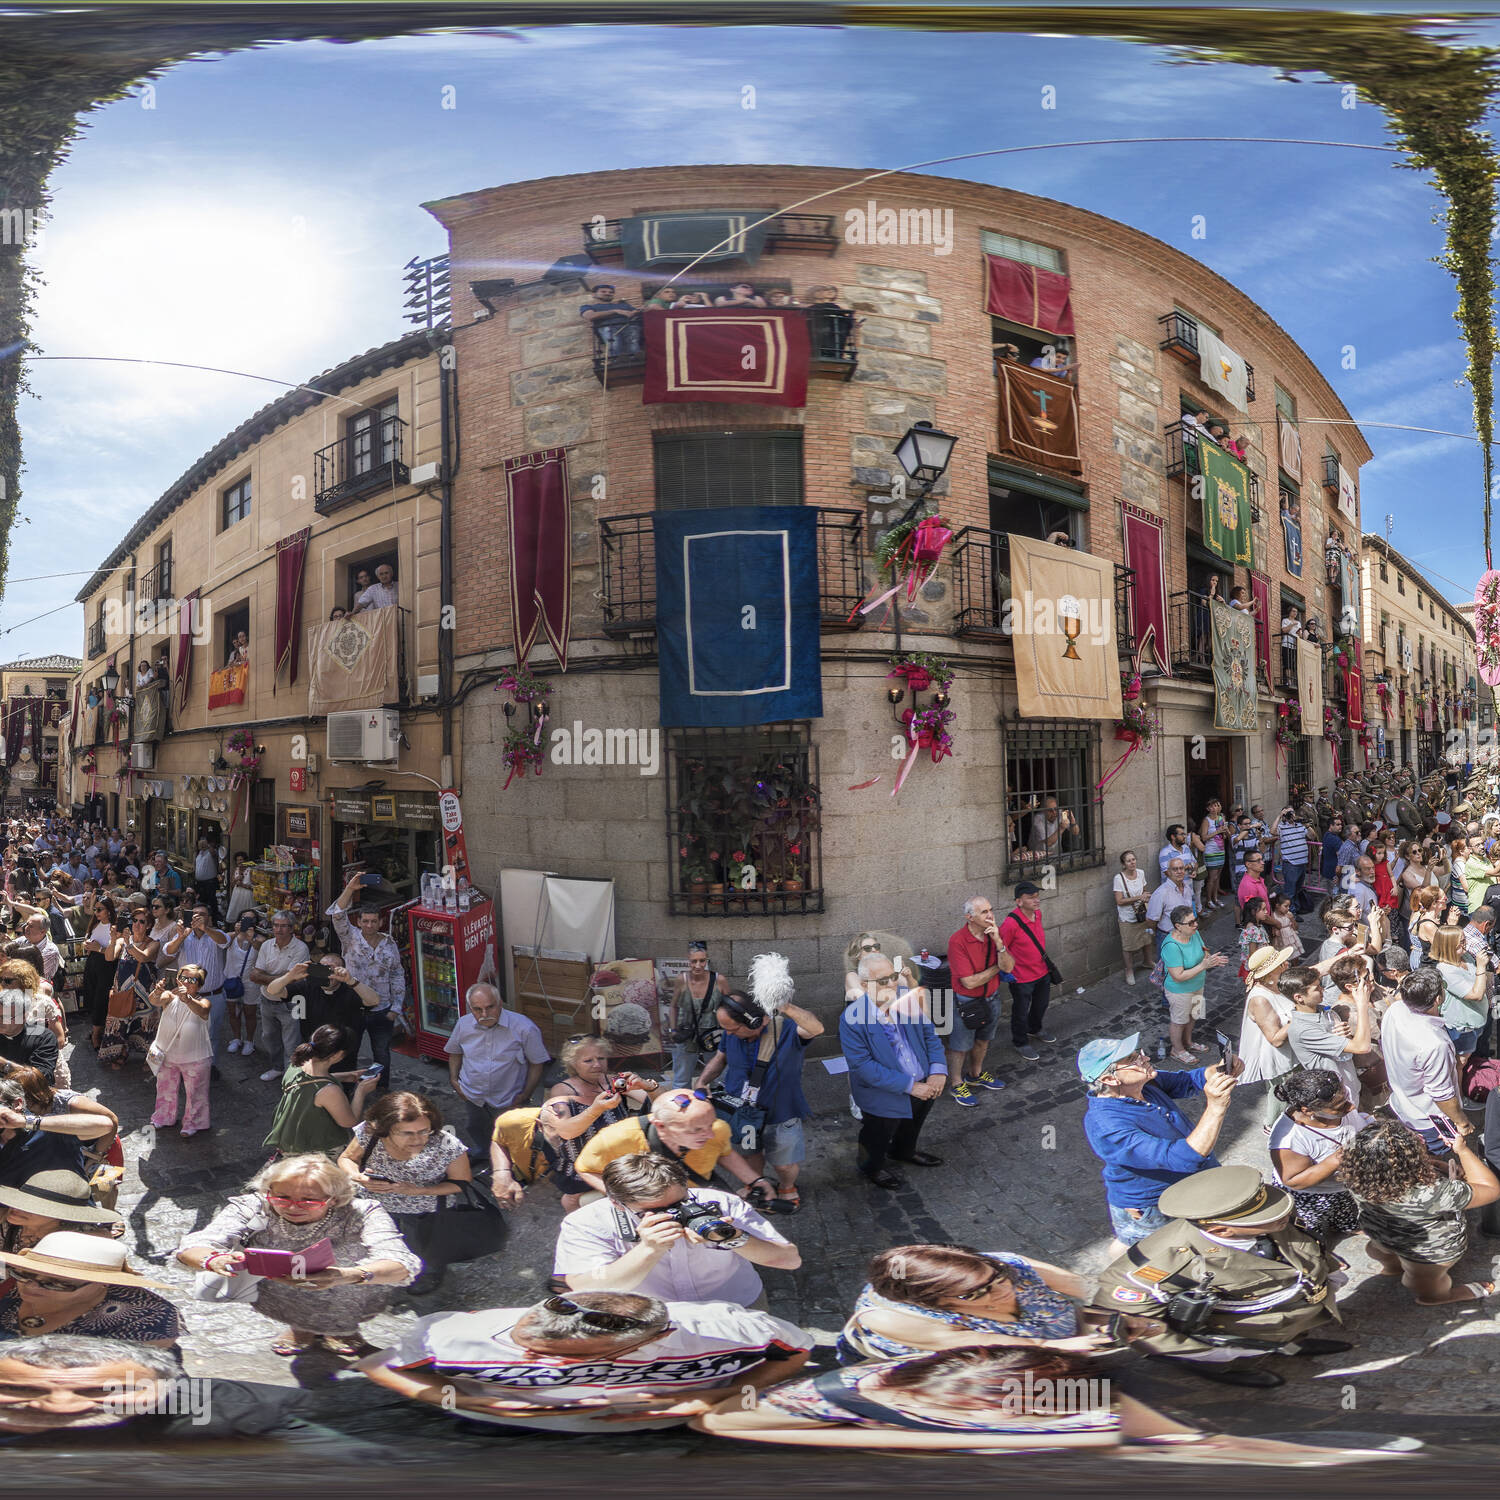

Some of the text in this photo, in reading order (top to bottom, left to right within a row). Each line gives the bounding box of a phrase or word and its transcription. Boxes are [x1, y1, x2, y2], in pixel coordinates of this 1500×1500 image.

[463, 914, 493, 938] LLÉVATEA
[464, 925, 494, 952] BIEN FRA
[473, 1355, 731, 1377] HARLEY
